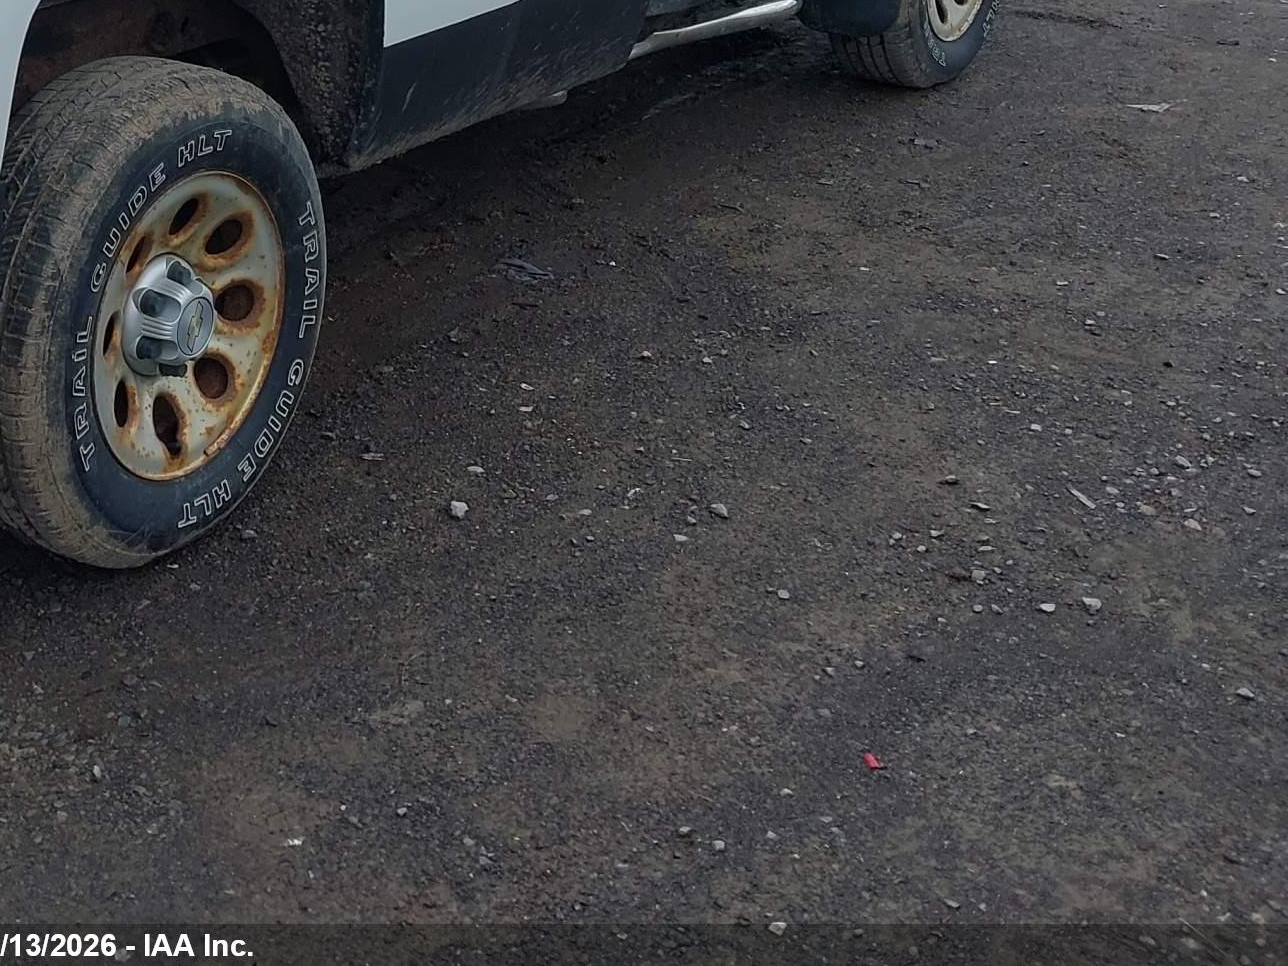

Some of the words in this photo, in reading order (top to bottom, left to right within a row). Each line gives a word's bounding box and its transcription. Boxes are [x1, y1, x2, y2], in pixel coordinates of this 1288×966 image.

[71, 314, 96, 473] TRAIL
[89, 163, 168, 294] GUIDE
[176, 128, 233, 169] HLT
[295, 201, 319, 340] TRAIL
[236, 358, 305, 483] GUIDE
[176, 479, 233, 530] HLT
